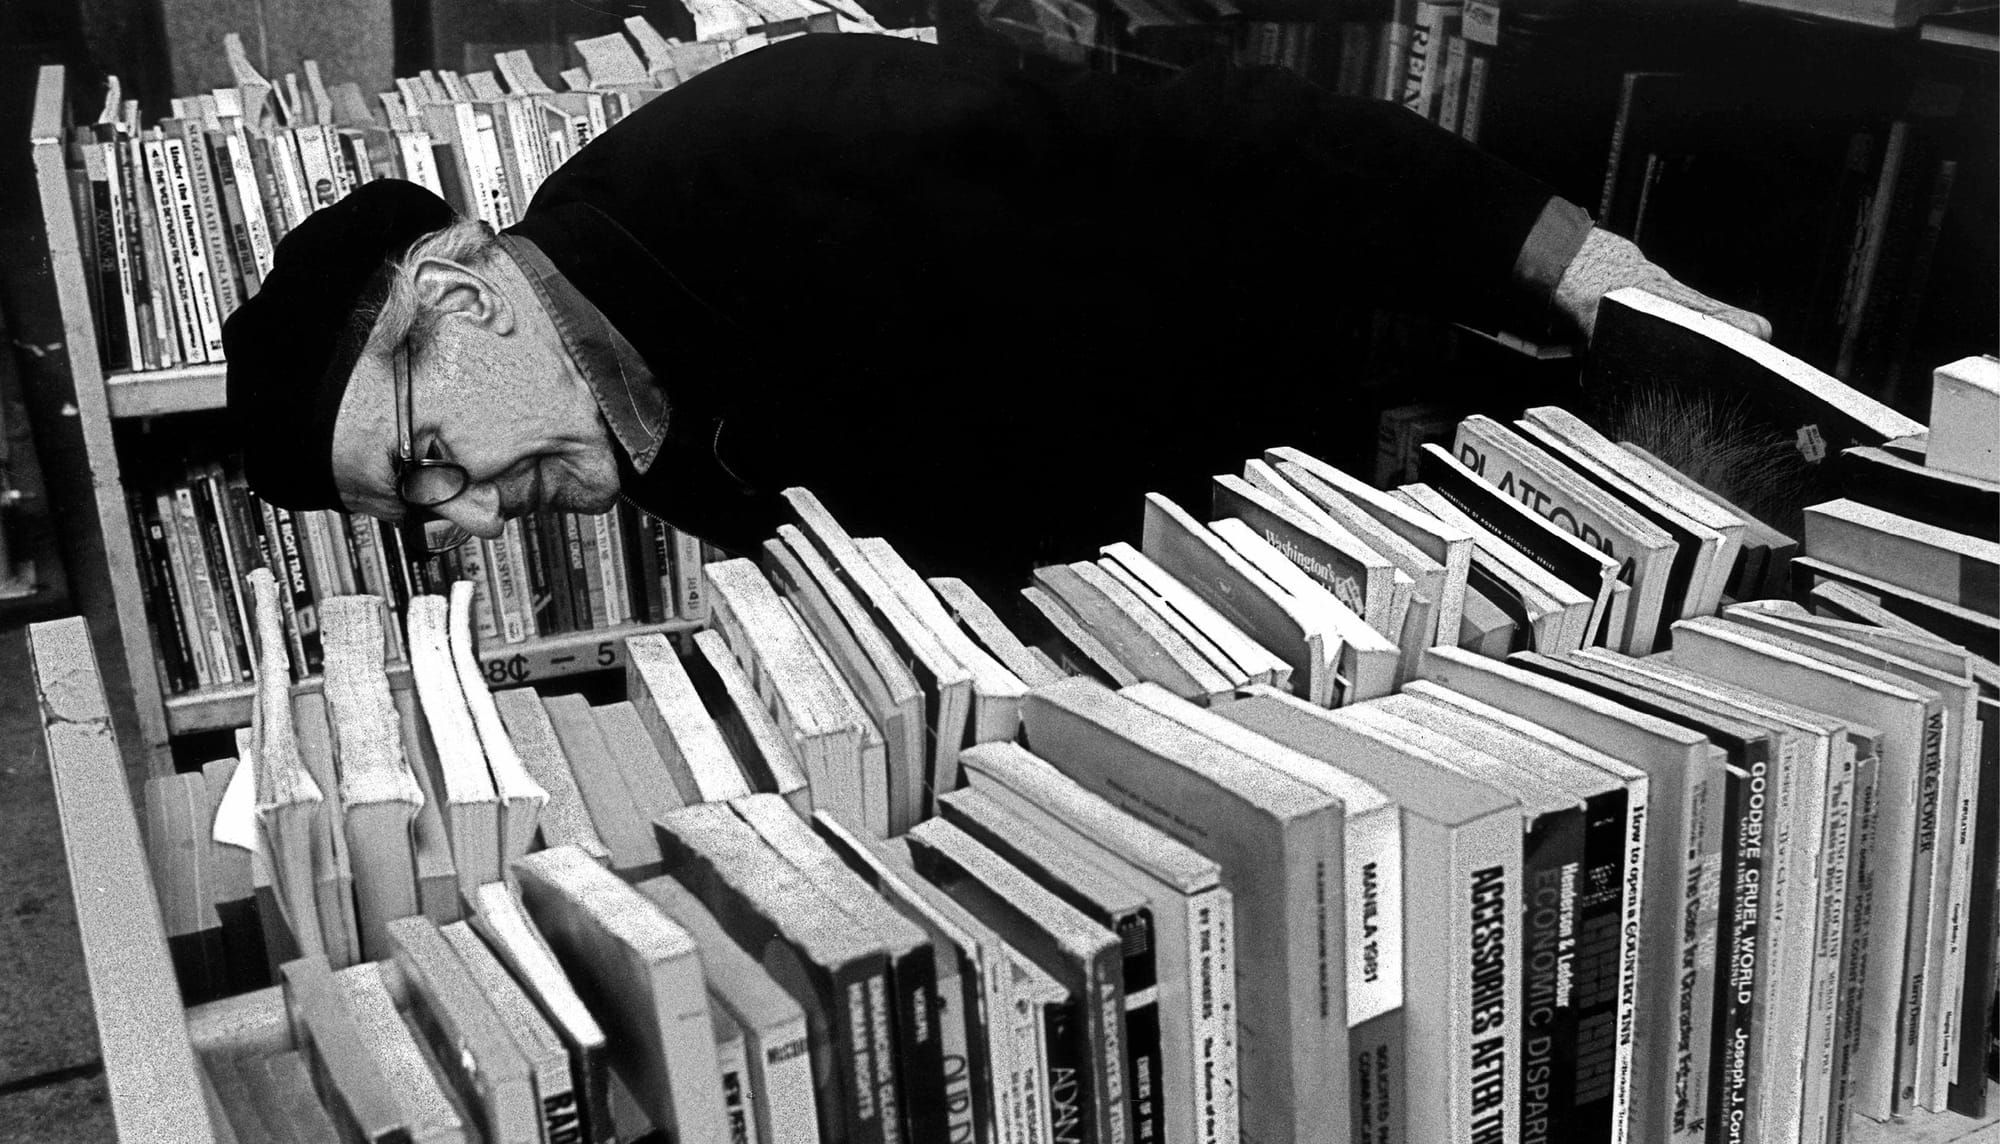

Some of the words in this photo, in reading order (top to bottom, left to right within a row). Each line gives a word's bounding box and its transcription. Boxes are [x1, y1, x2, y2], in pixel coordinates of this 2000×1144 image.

[170, 146, 184, 180] Under
[178, 183, 188, 201] the
[182, 205, 199, 257] Influence
[188, 124, 209, 194] SUGGESTED
[202, 195, 217, 231] STATE
[211, 236, 234, 313] LEGISLATION
[281, 523, 297, 556] RIGHT
[1265, 528, 1336, 584] Washington's
[1480, 517, 1502, 536] MODERN
[1503, 533, 1535, 557] SOCIOLOGY
[1536, 555, 1556, 571] SERIES
[288, 557, 306, 593] TRACK
[480, 653, 530, 683] 8¢
[597, 642, 617, 666] 5
[1925, 712, 1942, 773] WATER
[1632, 805, 1645, 843] How
[1747, 762, 1766, 859] GOODBYE
[1919, 791, 1937, 854] POWER
[1959, 798, 1970, 845] POPULATION
[1630, 847, 1642, 864] to
[1362, 862, 1379, 939] MANILA
[1558, 862, 1579, 938] Henderson
[1626, 867, 1640, 908] open
[1686, 864, 1702, 898] The
[1741, 868, 1760, 931] CRUEL
[1627, 908, 1638, 920] a
[1684, 898, 1701, 944] Case
[1200, 929, 1211, 953] THE
[1470, 865, 1505, 1036] ACCESSORIES
[1528, 868, 1559, 1027] ECONOMIC
[1557, 939, 1576, 952] &
[1682, 943, 1699, 969] for
[1848, 938, 1860, 983] COUNT
[1100, 983, 1115, 1000] A
[1555, 953, 1575, 1007] Ledebur
[1738, 936, 1755, 1004] WORLD
[1909, 974, 1923, 1006] Harry
[1619, 1009, 1633, 1046] INN
[1678, 969, 1697, 1053] Character
[1844, 986, 1857, 1040] BIDDING
[1908, 1007, 1921, 1046] Dennis
[1101, 999, 1123, 1101] REPORTER
[1731, 1028, 1749, 1088] Joseph
[853, 1051, 875, 1120] RIGHTS
[1470, 1036, 1505, 1117] AFTER
[1731, 1091, 1744, 1106] J.
[1721, 1086, 1733, 1127] KASPER
